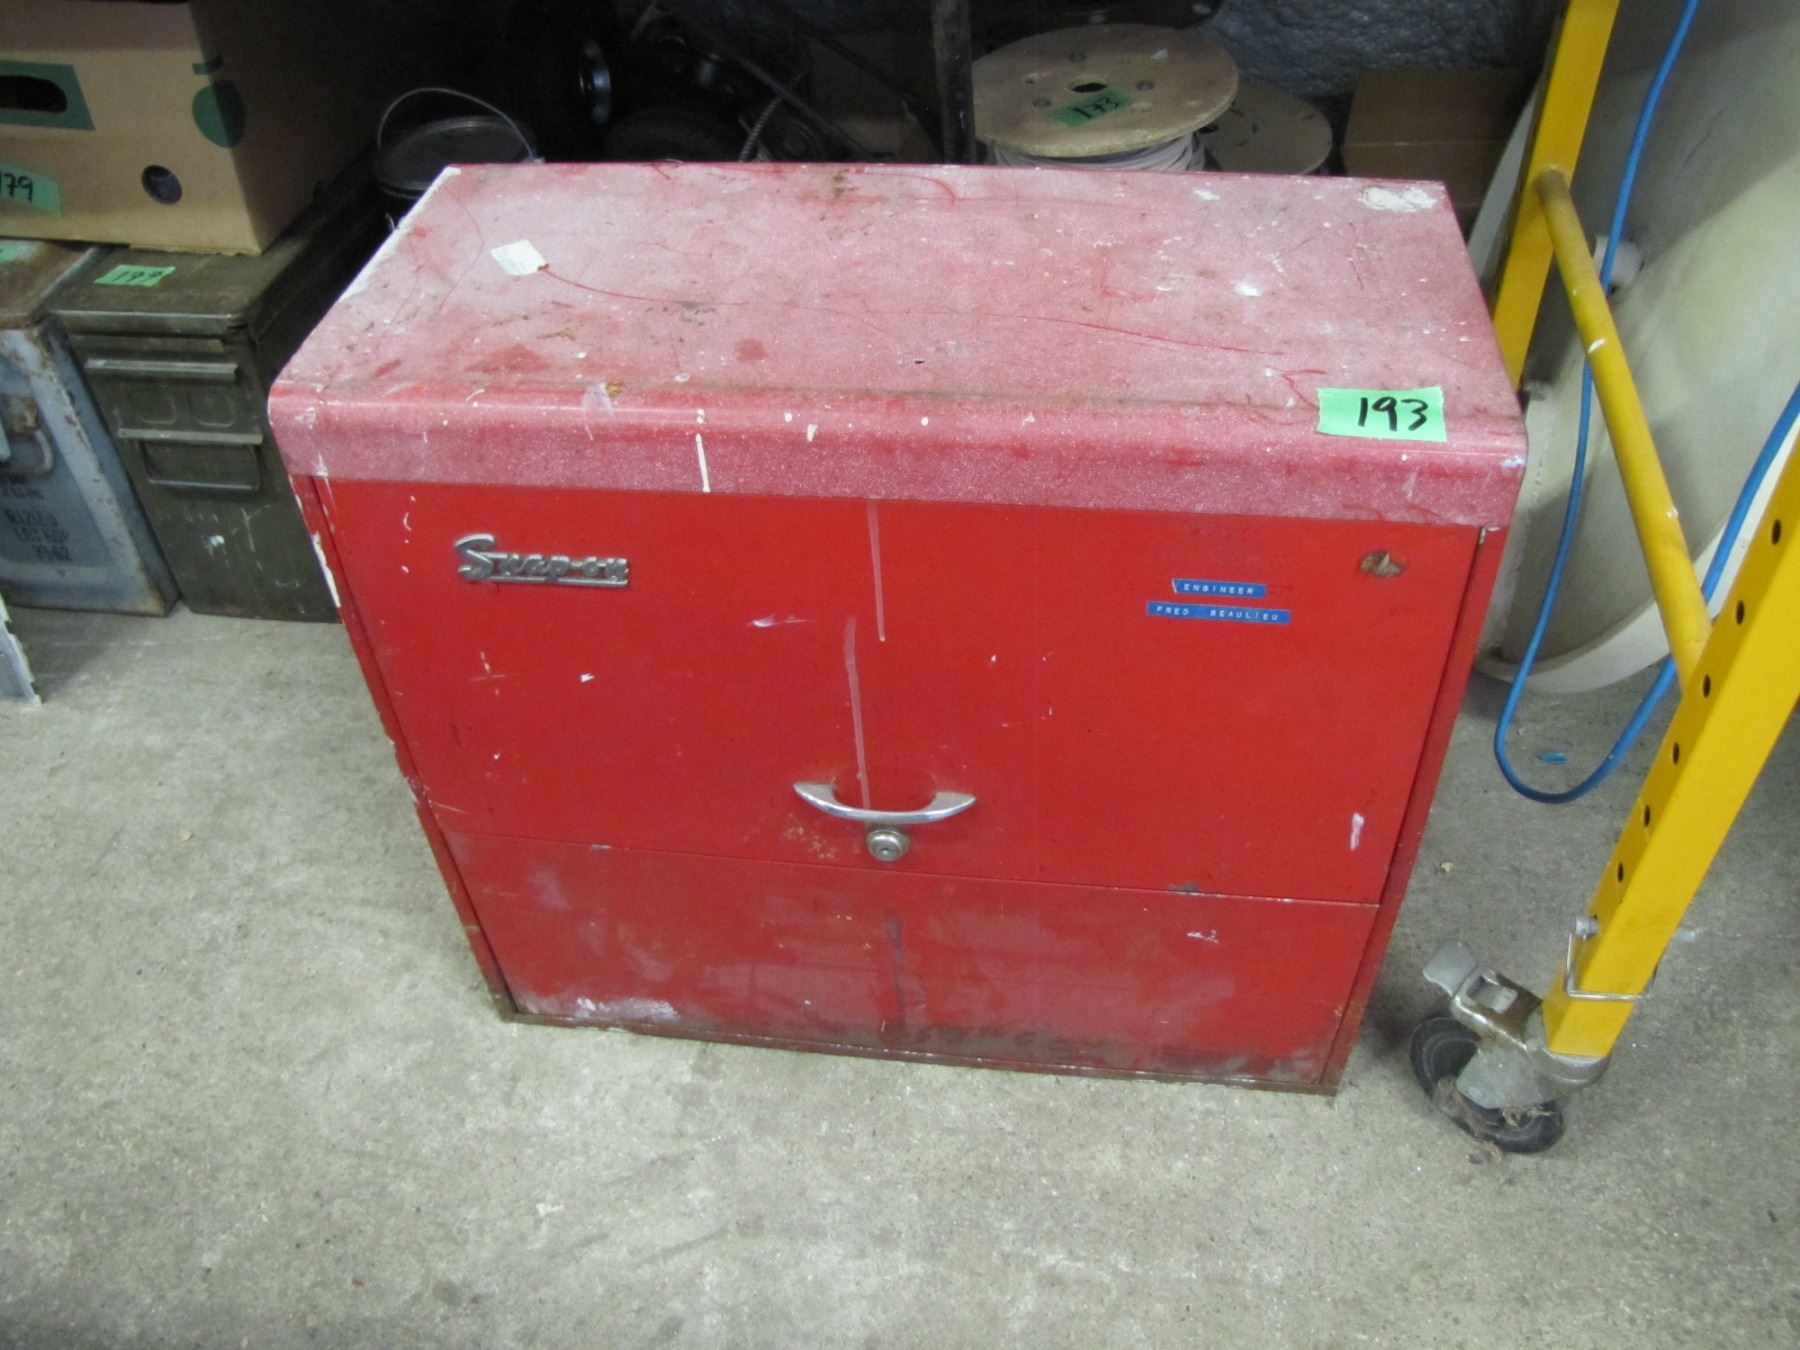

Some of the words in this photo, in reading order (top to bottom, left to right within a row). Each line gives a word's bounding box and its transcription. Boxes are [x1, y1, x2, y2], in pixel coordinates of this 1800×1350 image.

[1072, 96, 1120, 119] 173
[1357, 396, 1429, 432] 193
[454, 532, 630, 588] Snap-on
[1183, 582, 1255, 596] ENGINEER
[1156, 605, 1190, 617] FRED
[1209, 608, 1279, 622] BEAULIEU
